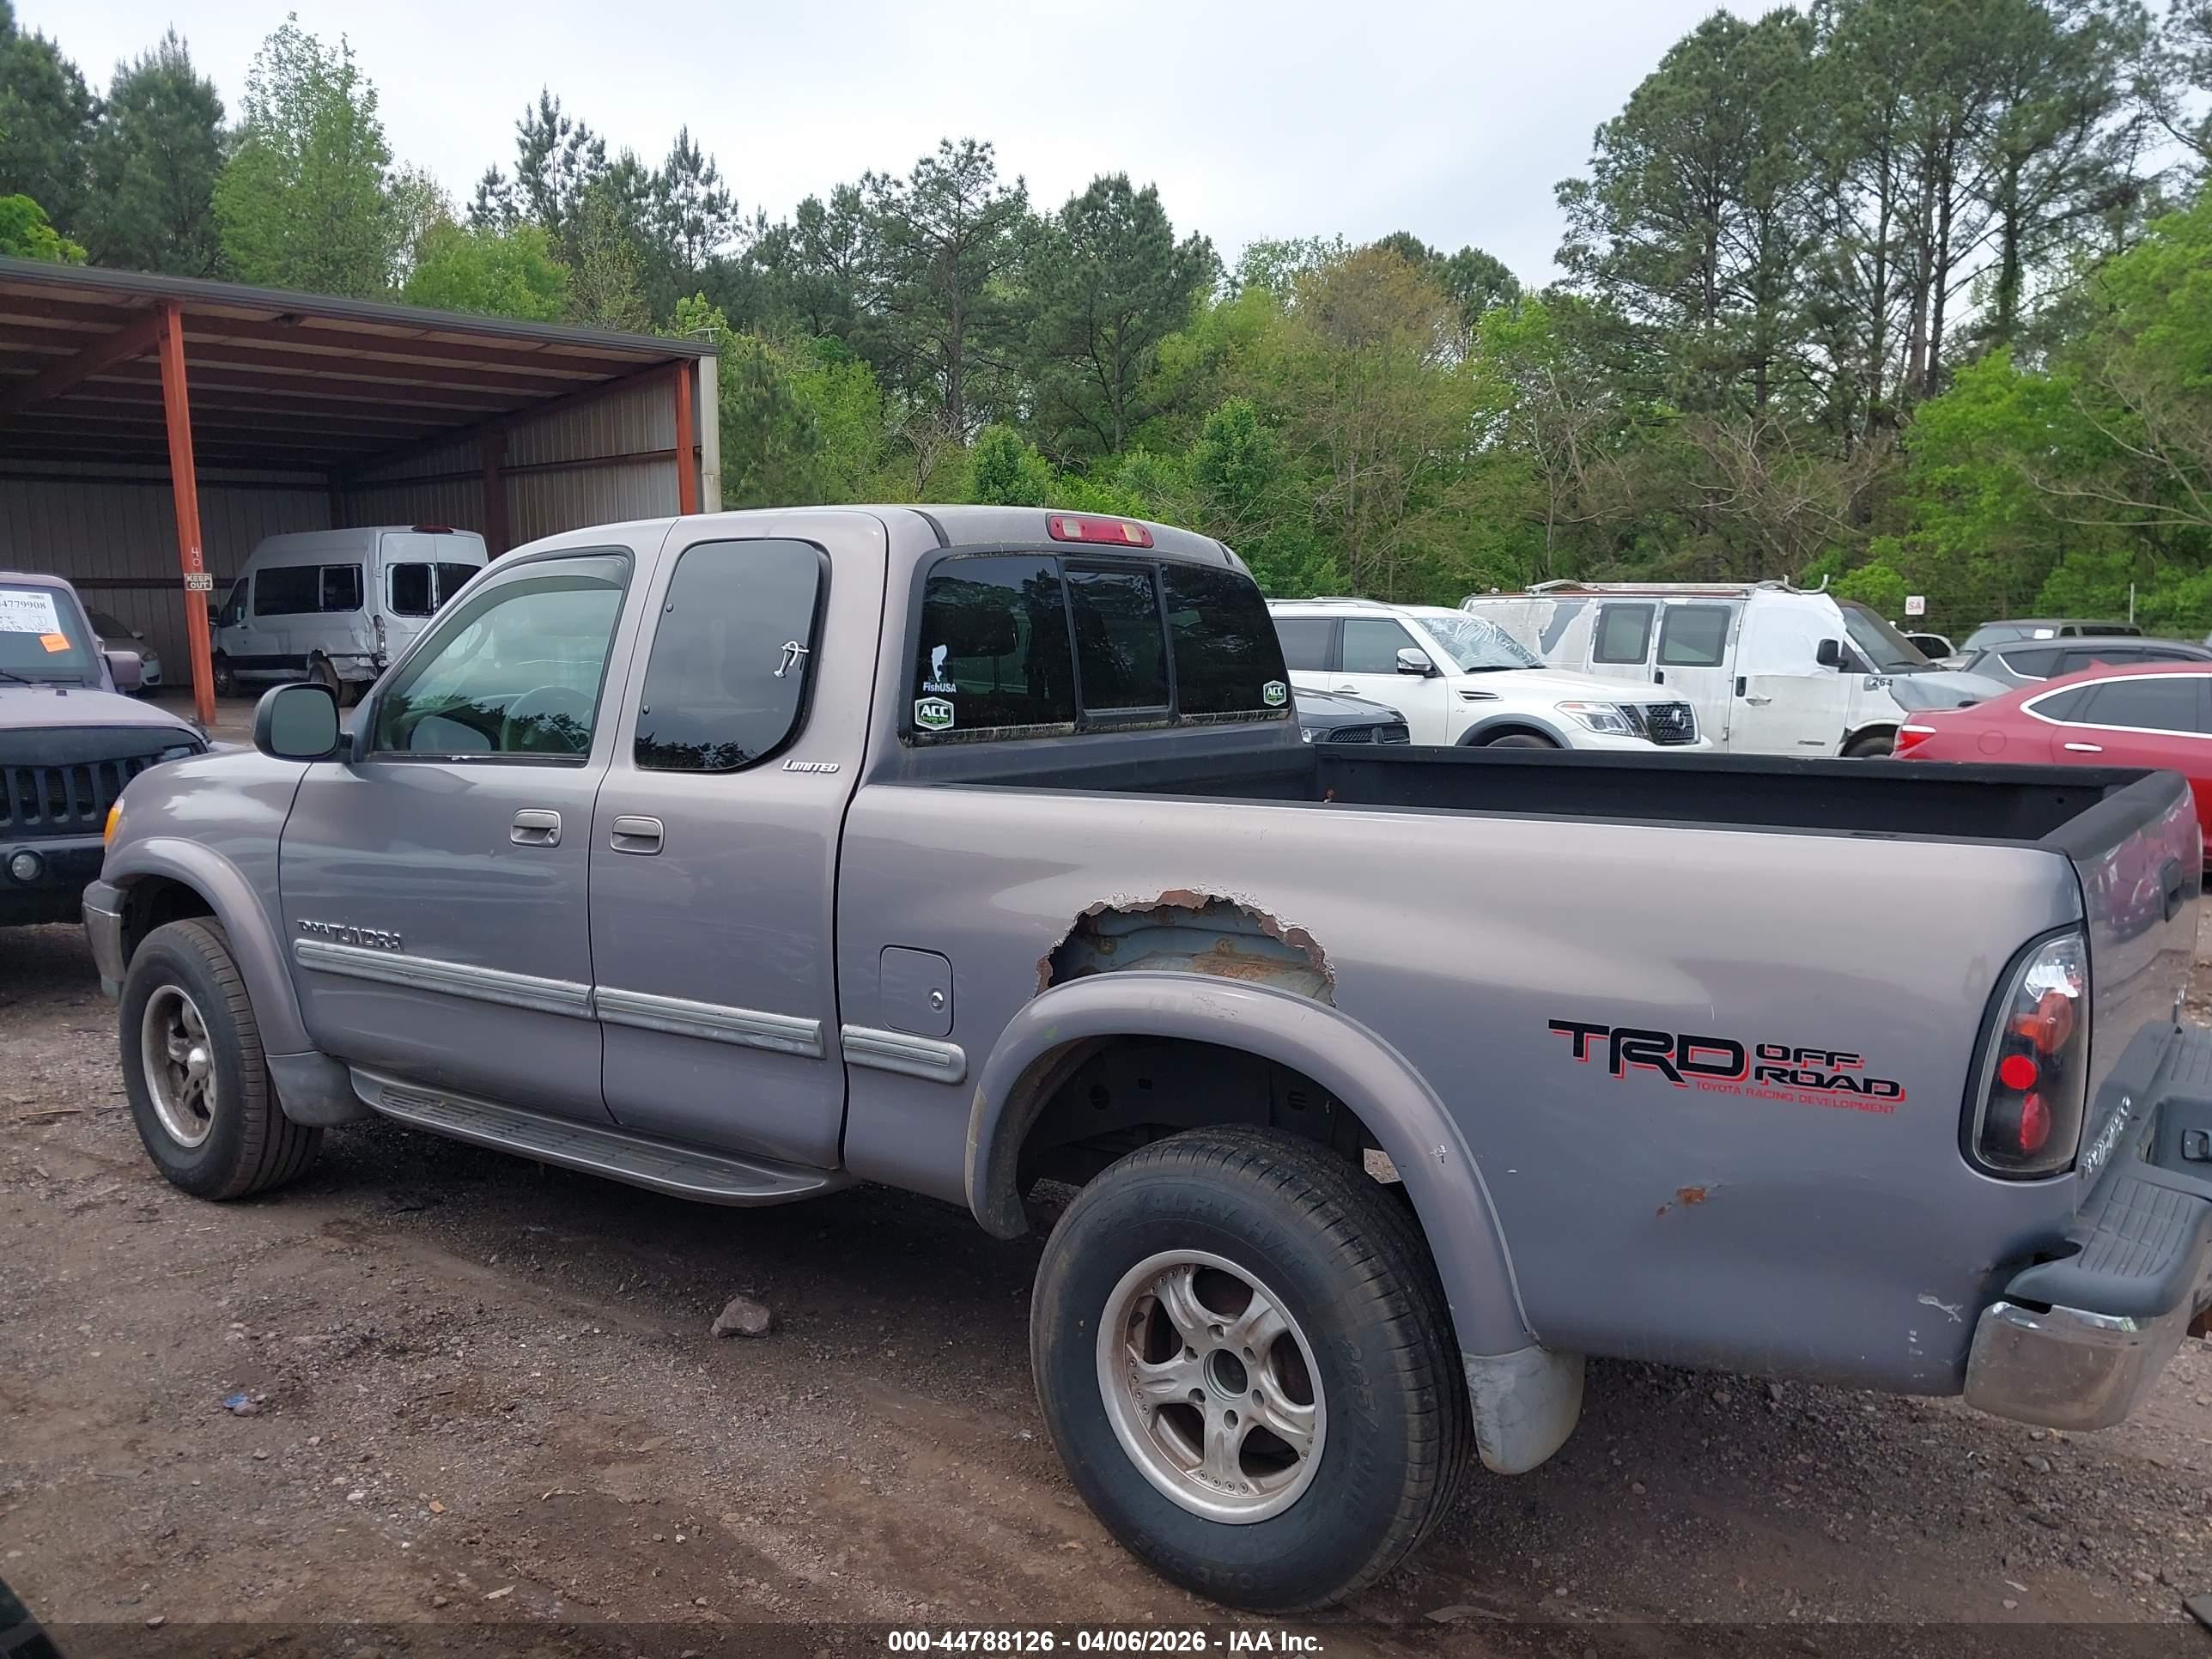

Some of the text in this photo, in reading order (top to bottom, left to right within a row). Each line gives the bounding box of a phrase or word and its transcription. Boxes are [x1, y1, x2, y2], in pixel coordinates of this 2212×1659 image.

[0, 599, 46, 610] 4779908
[922, 682, 957, 693] FishUSA
[1267, 686, 1284, 696] ACC
[920, 704, 949, 718] ACC
[329, 923, 404, 952] TUNDRA
[1548, 1018, 1749, 1088] TRD
[1756, 1043, 1865, 1072] OFF
[1696, 1080, 1896, 1115] TOYOTA RACING DEVELOPMENT
[1754, 1065, 1905, 1103] ROAD
